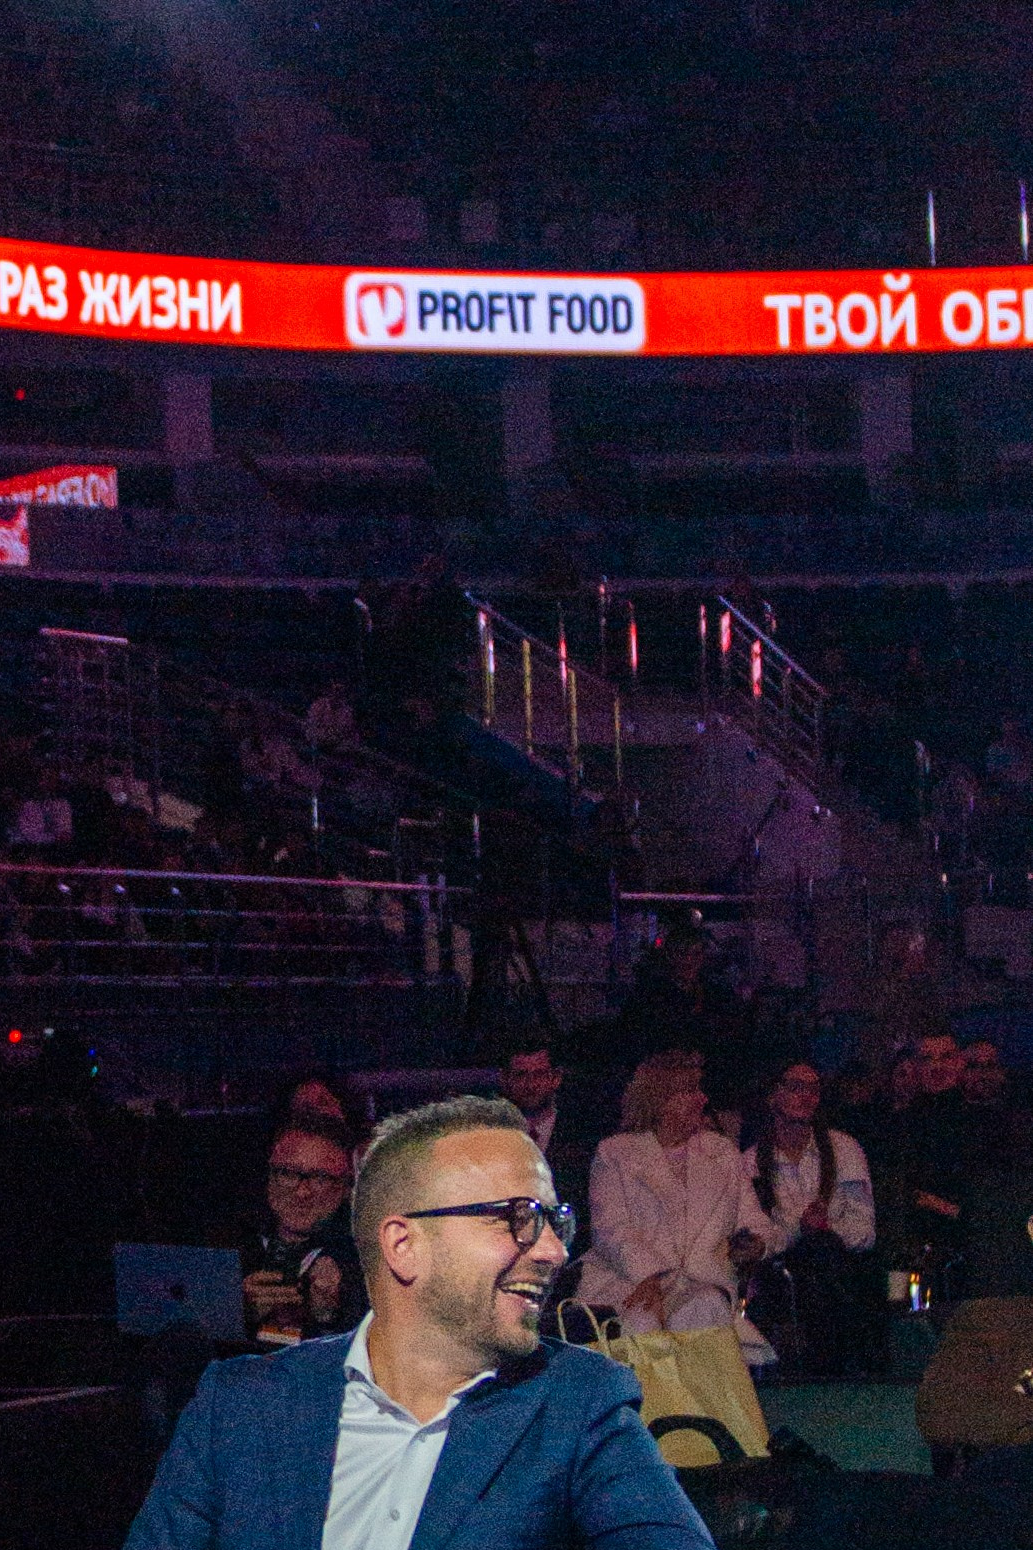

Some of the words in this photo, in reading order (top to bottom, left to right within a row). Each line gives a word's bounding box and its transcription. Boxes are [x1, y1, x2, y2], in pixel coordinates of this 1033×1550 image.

[79, 270, 242, 334] ЖИЗНИ
[418, 290, 535, 333] PROFIT
[548, 293, 633, 334] FOOD
[763, 272, 917, 348] ТВОЙ
[941, 289, 1033, 346] ОБ
